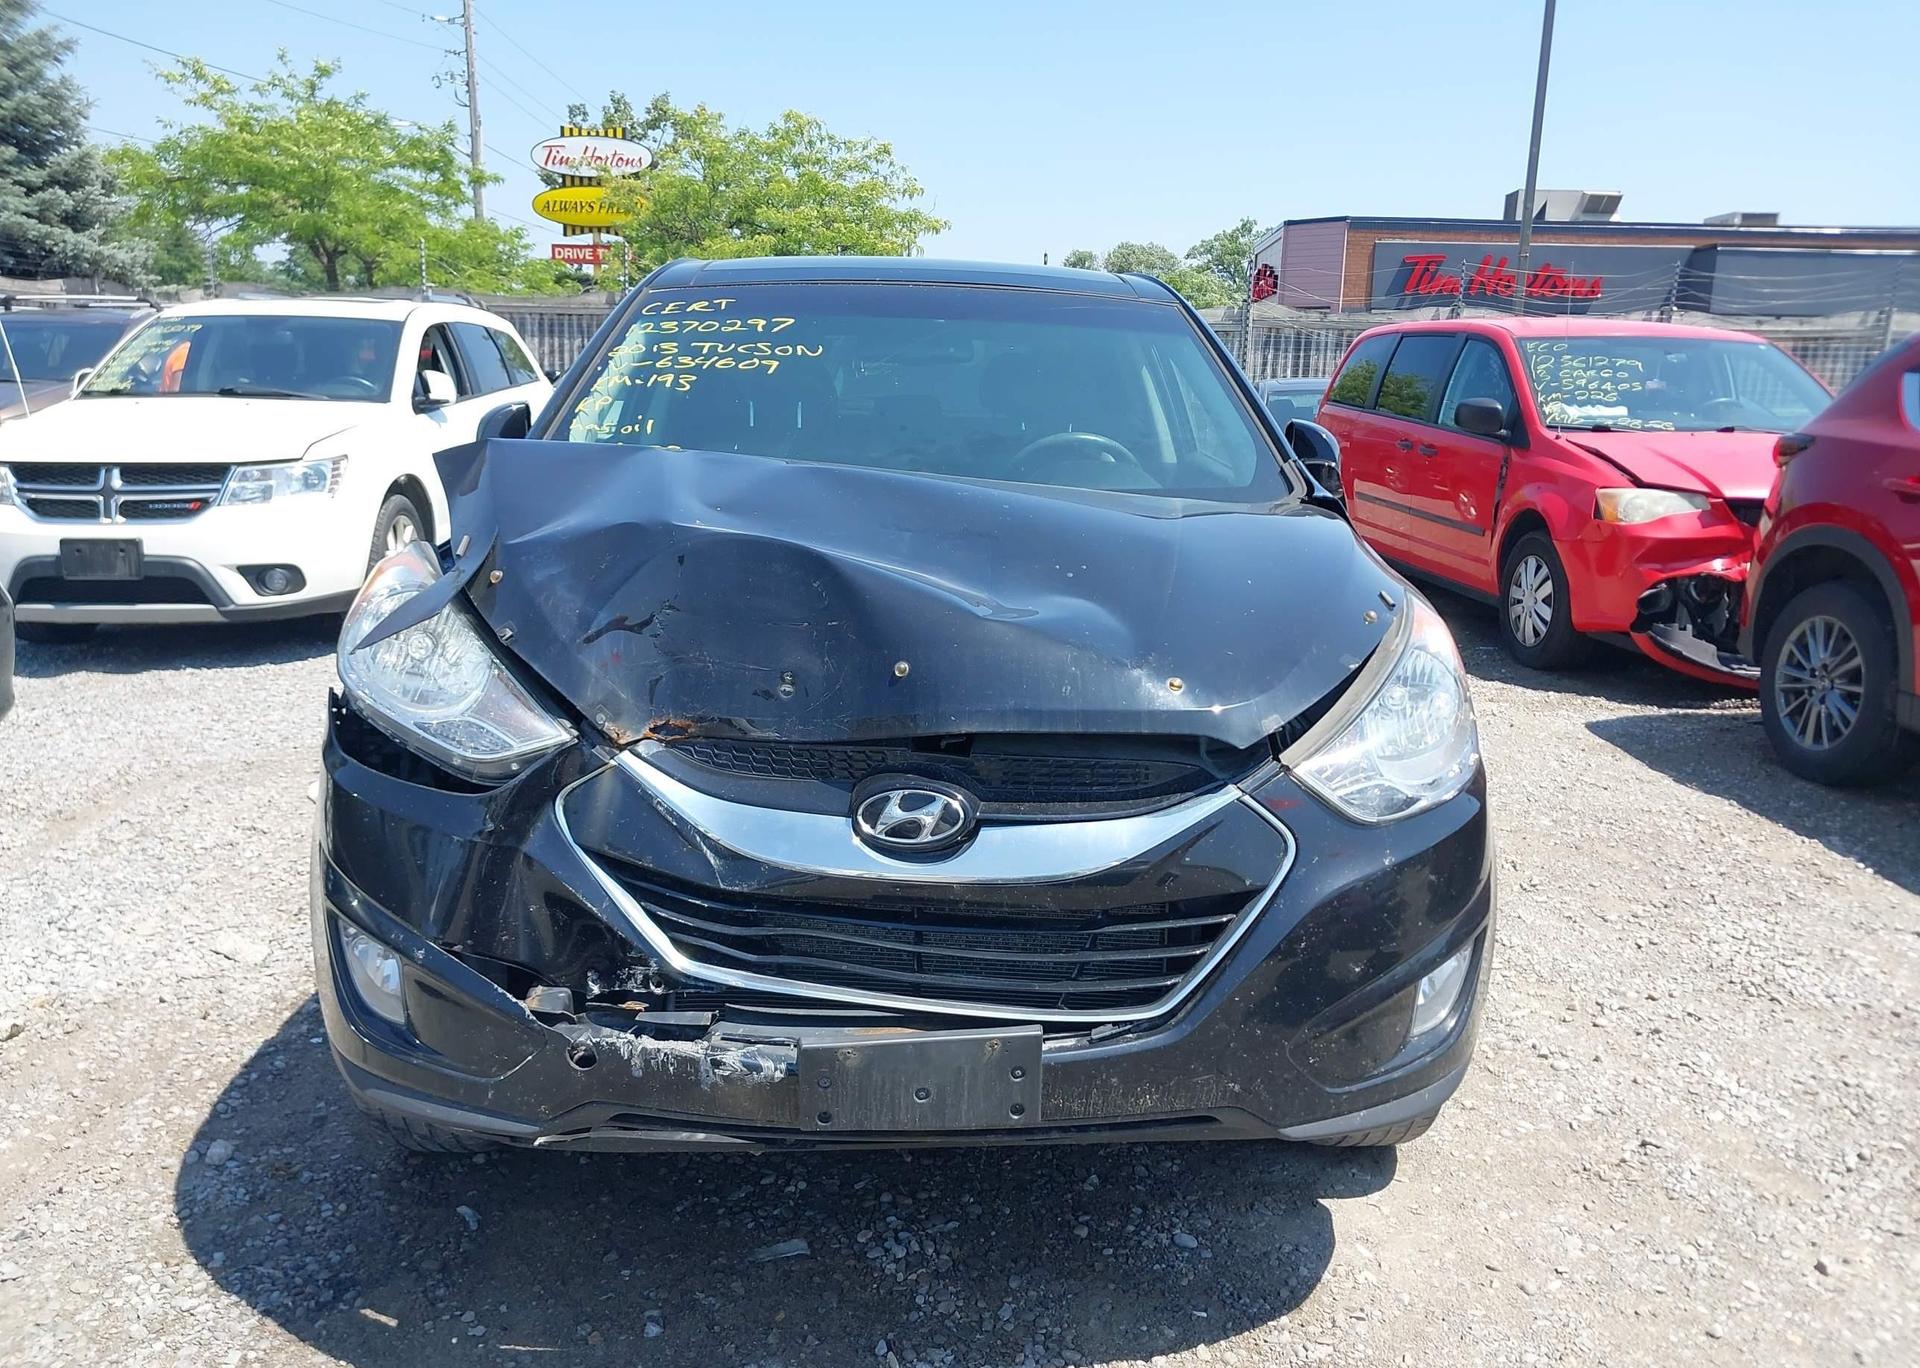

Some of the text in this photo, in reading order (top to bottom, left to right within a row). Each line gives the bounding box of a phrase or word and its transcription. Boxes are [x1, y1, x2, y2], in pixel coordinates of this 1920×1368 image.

[578, 145, 643, 169] Hortons
[541, 199, 596, 214] ALWAYS
[554, 247, 594, 260] DRIVE
[1403, 253, 1604, 298] Tim Hotons
[641, 298, 736, 315] CERT
[690, 342, 823, 357] TUCSON
[1526, 341, 1568, 353] ECO
[1559, 369, 1629, 379] CARGO
[620, 414, 654, 435] oil
